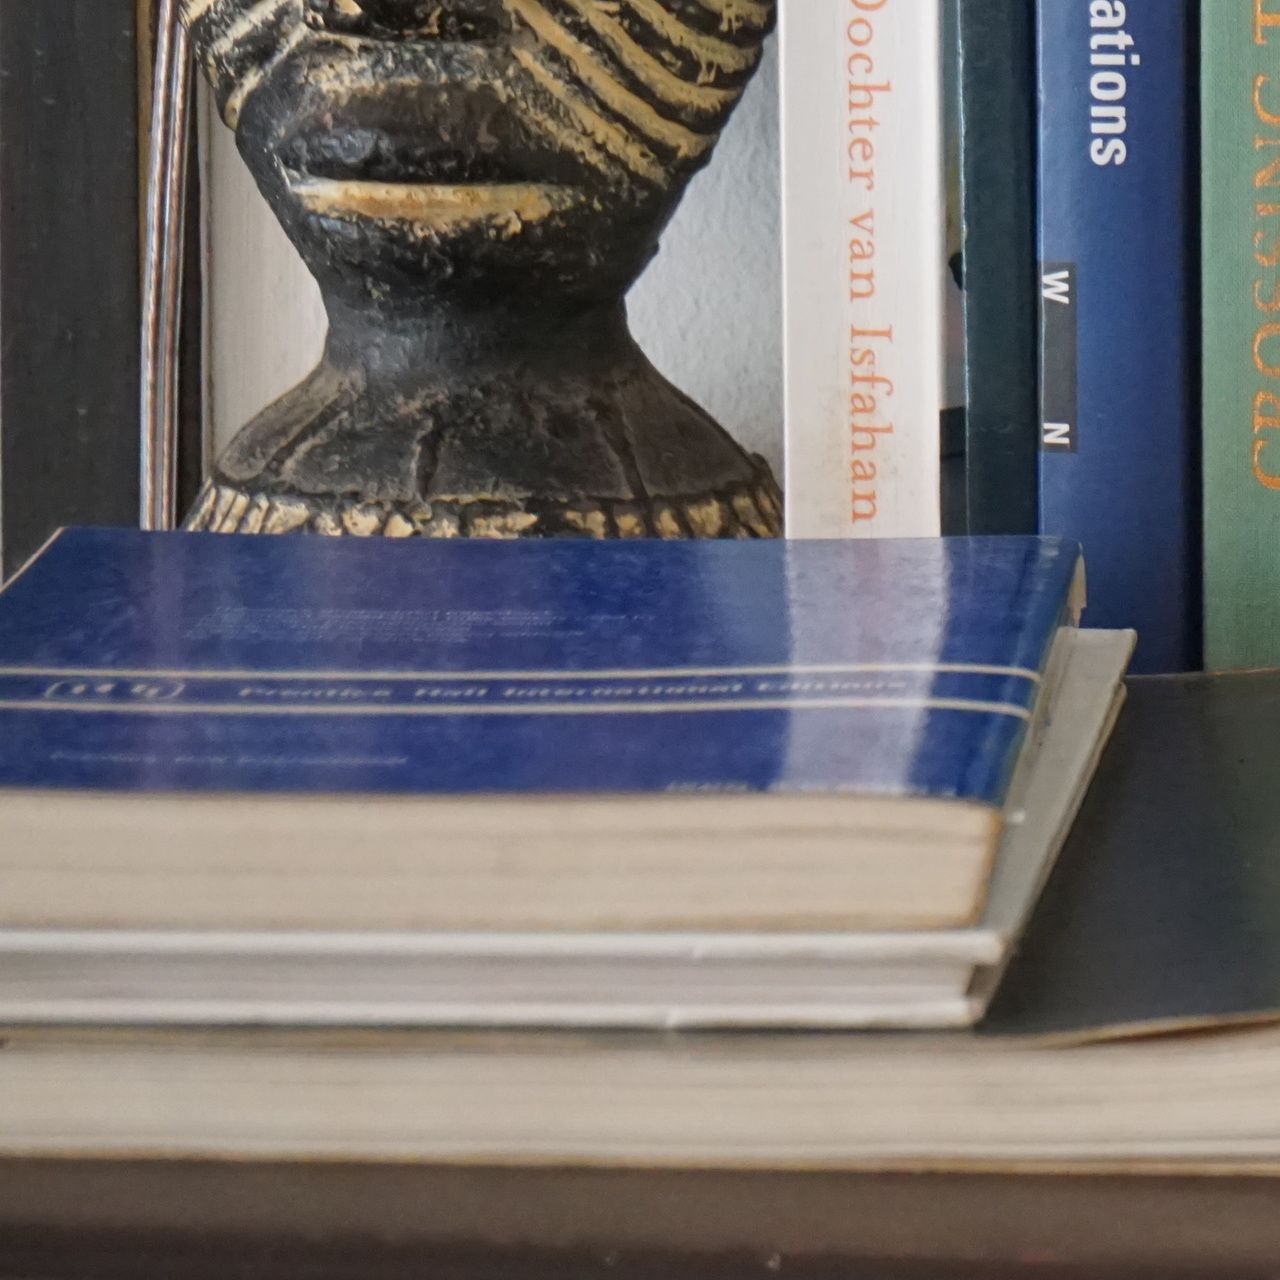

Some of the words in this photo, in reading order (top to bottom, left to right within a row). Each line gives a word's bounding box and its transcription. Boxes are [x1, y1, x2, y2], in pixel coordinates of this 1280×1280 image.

[848, 210, 876, 302] van
[1042, 270, 1070, 305] W
[850, 325, 894, 523] Isfahan
